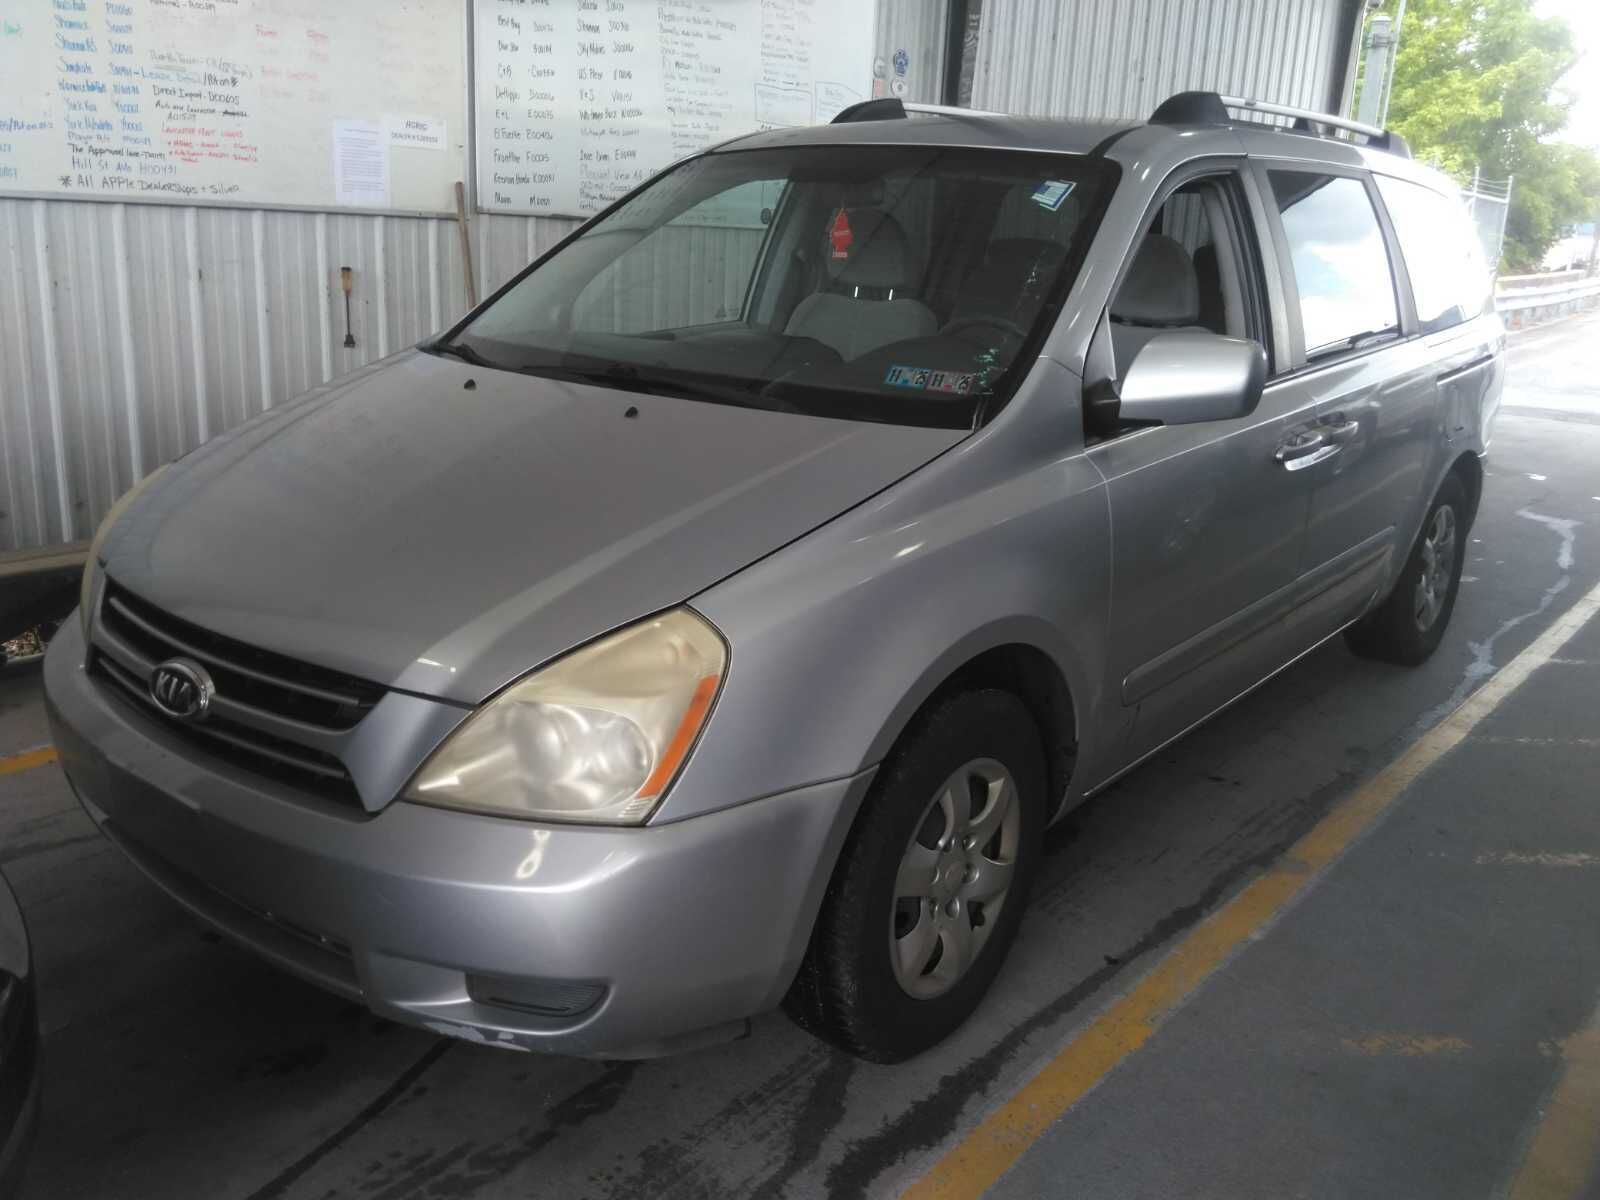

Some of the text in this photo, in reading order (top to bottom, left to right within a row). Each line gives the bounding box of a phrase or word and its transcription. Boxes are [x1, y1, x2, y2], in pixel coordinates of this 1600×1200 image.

[72, 155, 92, 170] Hill
[77, 174, 93, 187] All
[155, 671, 191, 704] KIA
